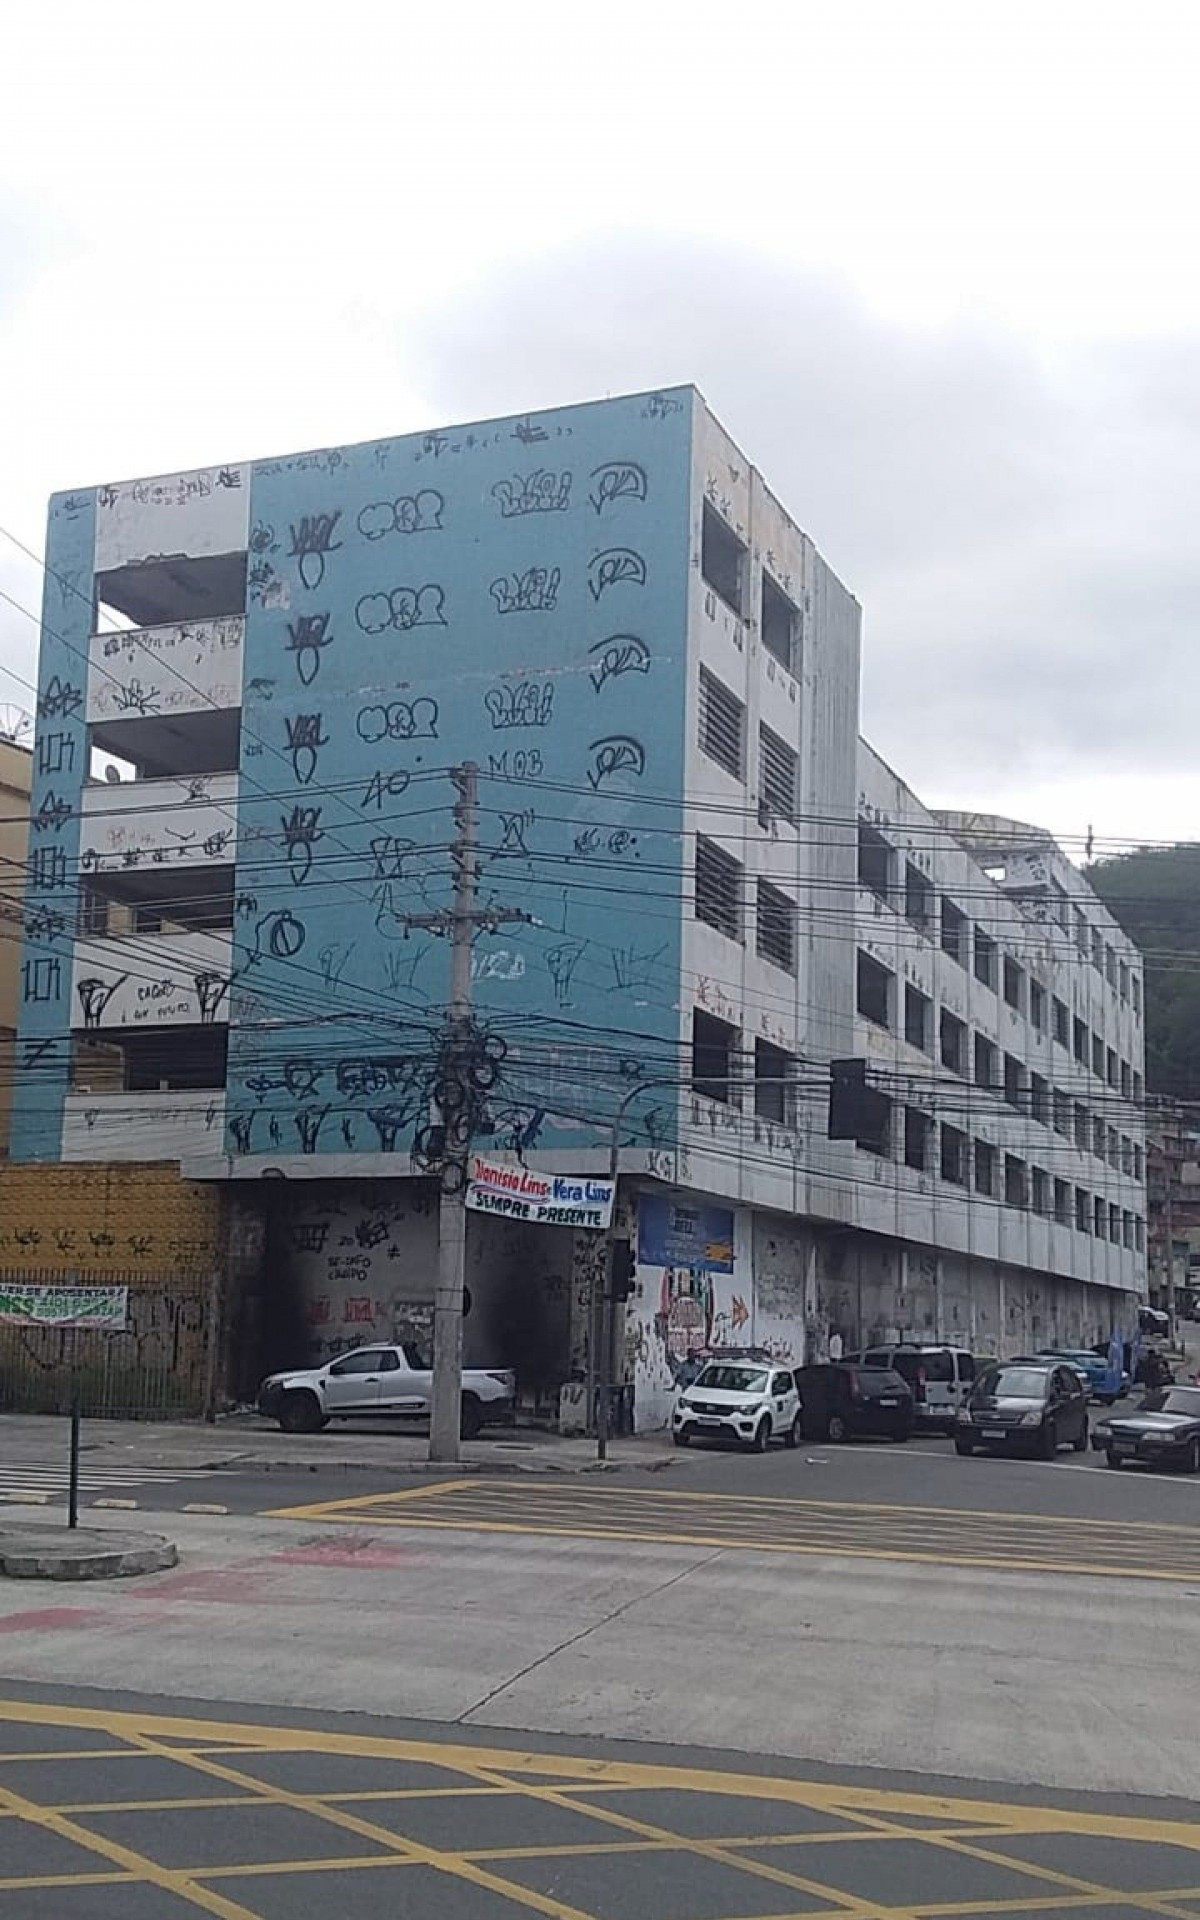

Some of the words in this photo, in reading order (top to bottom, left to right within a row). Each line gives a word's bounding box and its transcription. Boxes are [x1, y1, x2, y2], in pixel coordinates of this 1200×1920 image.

[553, 1177, 582, 1200] Vera
[476, 1192, 530, 1217] SEMPRE
[537, 1205, 602, 1226] PRESENTE
